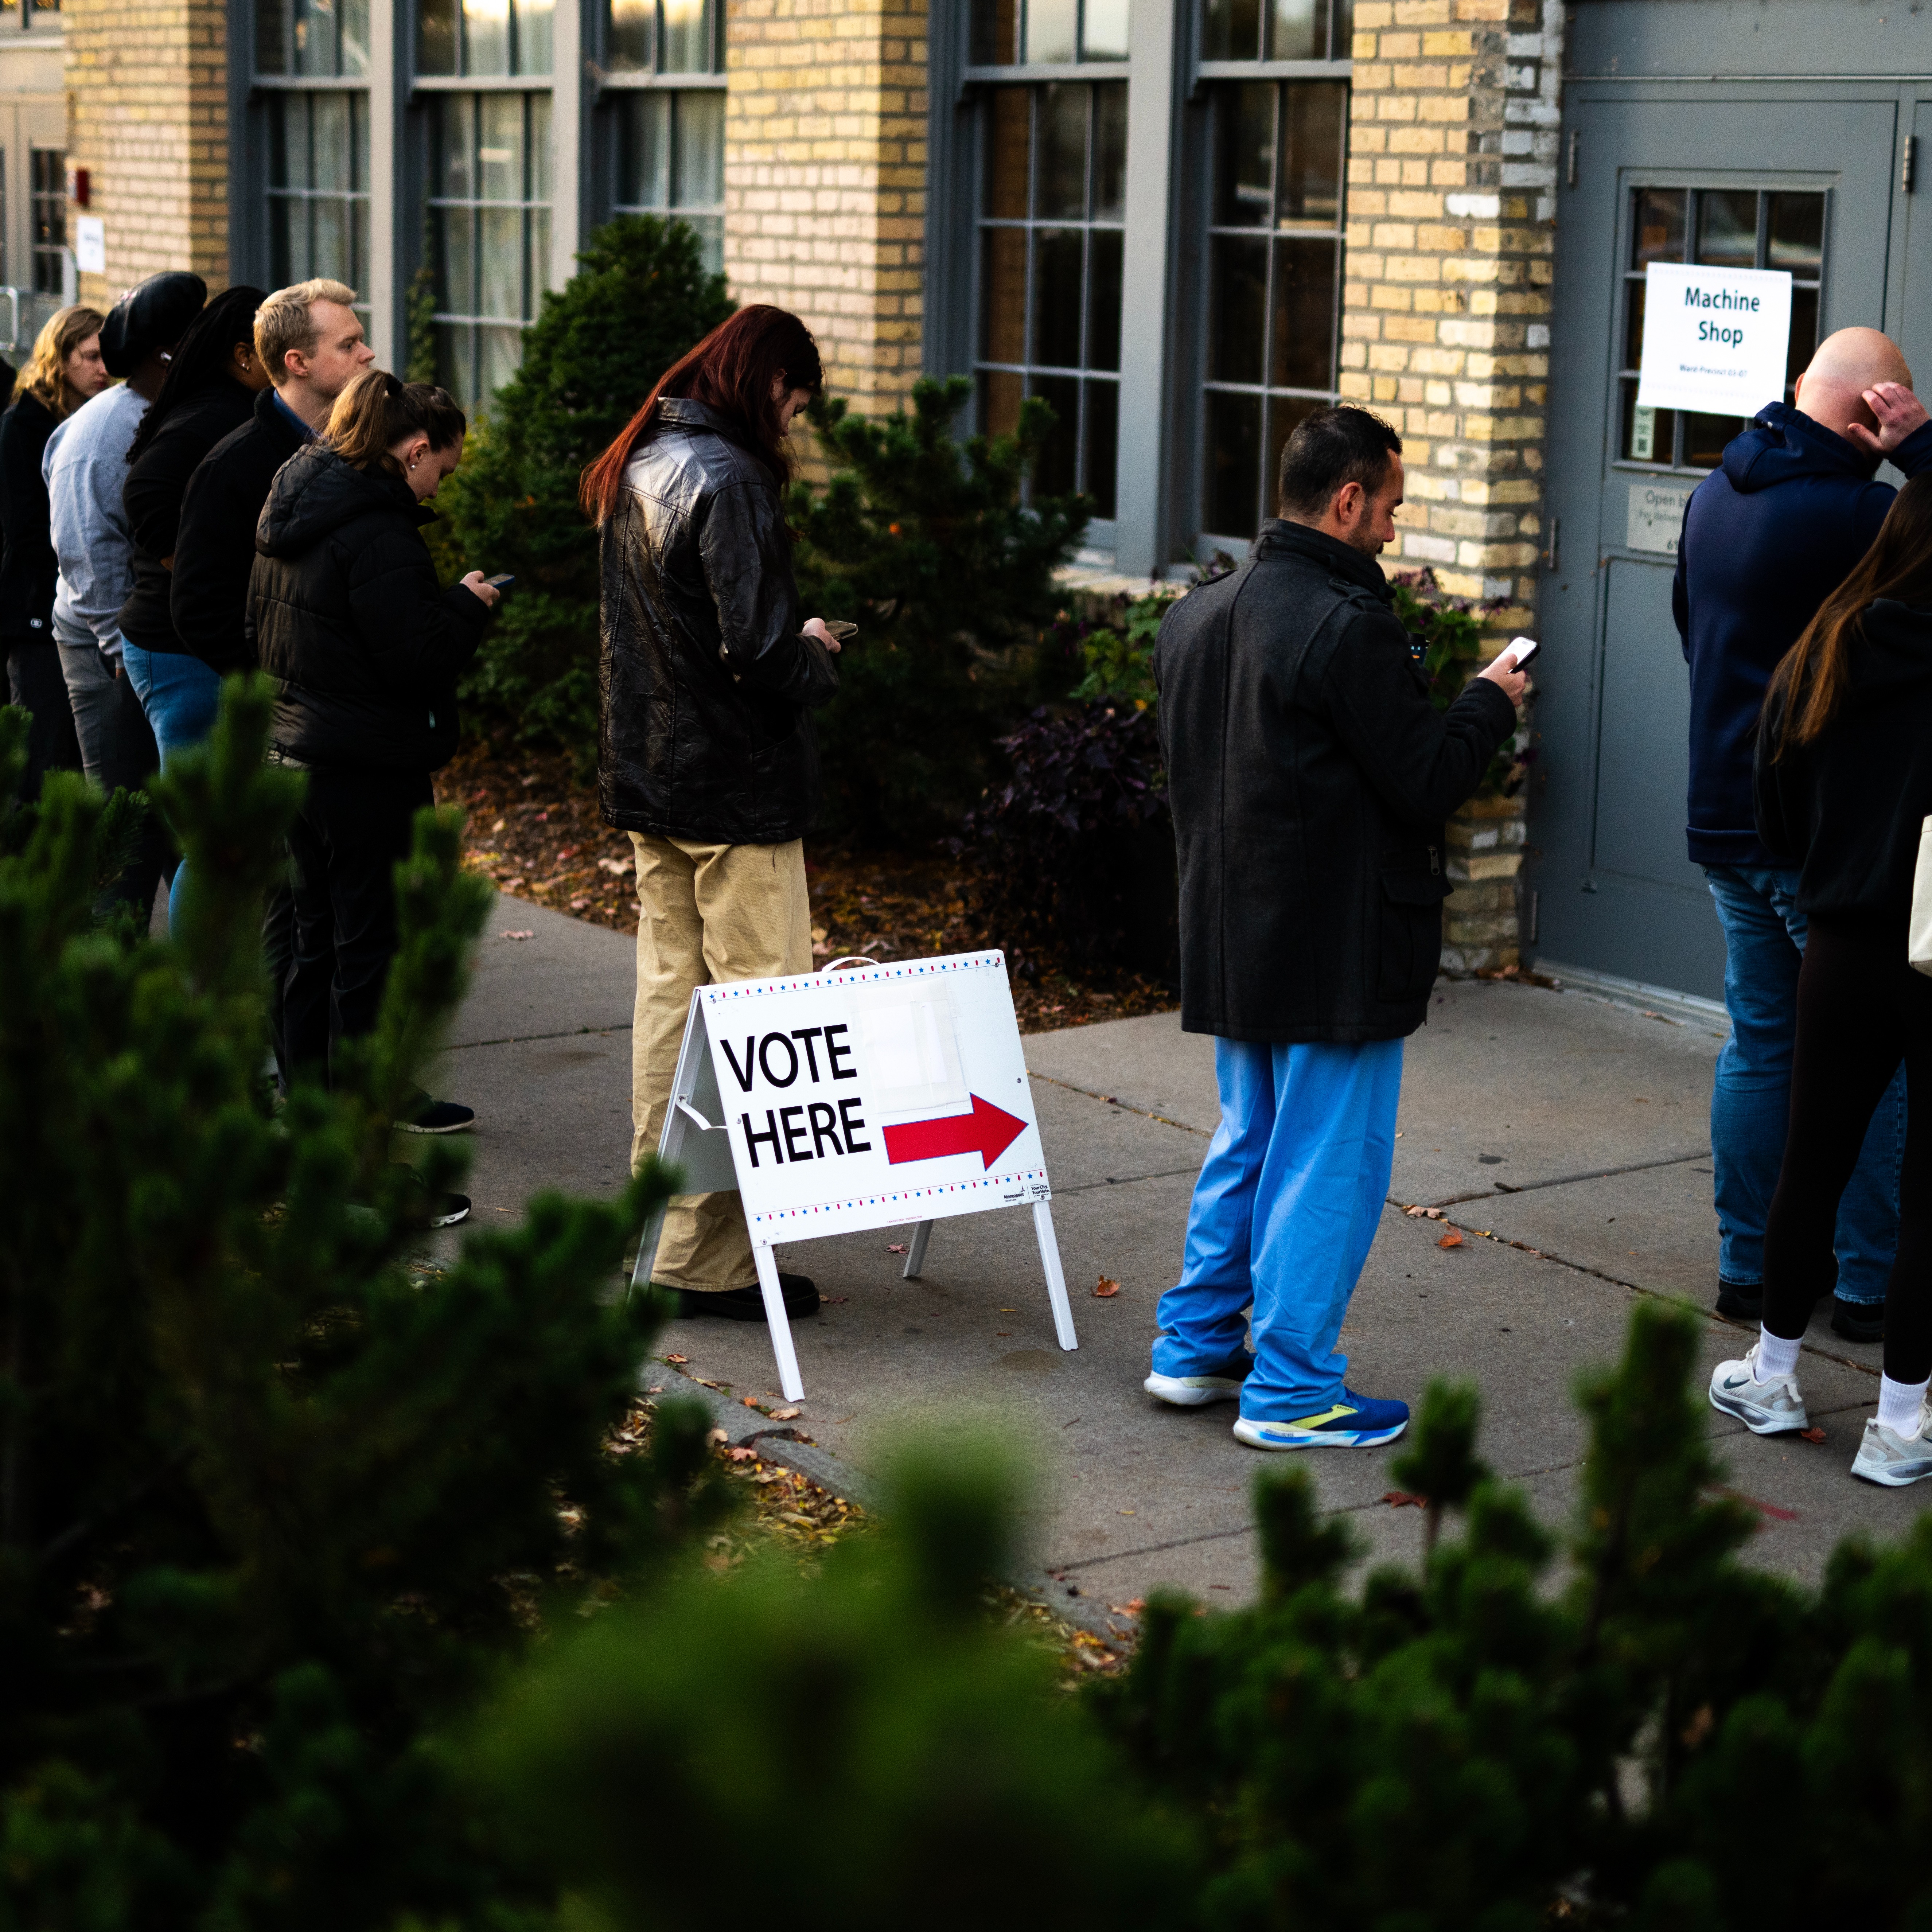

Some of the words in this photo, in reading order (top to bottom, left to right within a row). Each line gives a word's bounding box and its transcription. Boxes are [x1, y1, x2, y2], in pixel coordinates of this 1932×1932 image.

[1685, 287, 1760, 312] Machine
[1699, 320, 1743, 349] Shop
[1645, 490, 1676, 508] Open
[720, 1024, 857, 1092] VOTE
[741, 1097, 872, 1168] HERE
